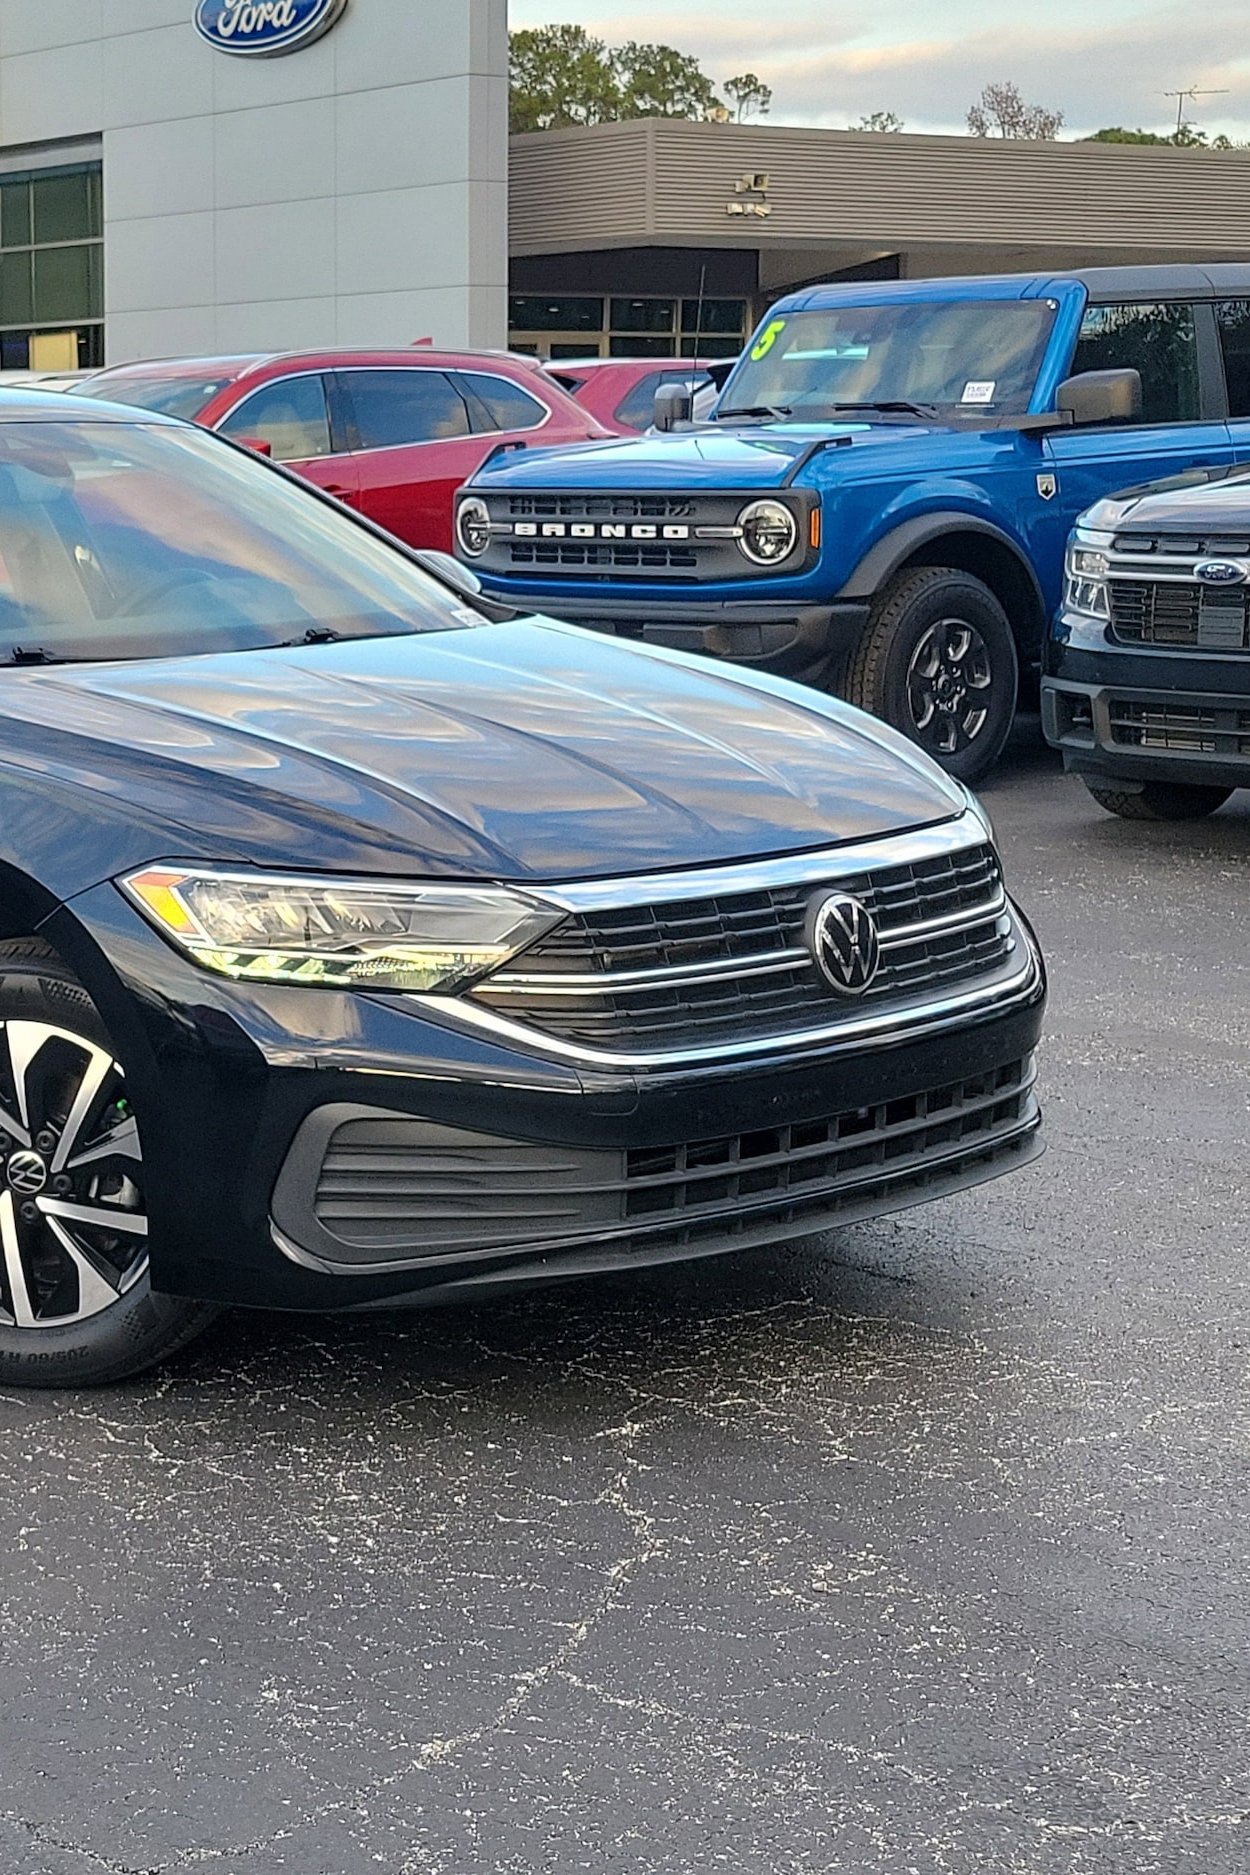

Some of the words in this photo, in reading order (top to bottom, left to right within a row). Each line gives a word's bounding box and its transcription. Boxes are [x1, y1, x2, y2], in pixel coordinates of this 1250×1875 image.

[217, 0, 297, 38] Ford
[751, 320, 786, 361] 5
[514, 522, 689, 539] BRONCO
